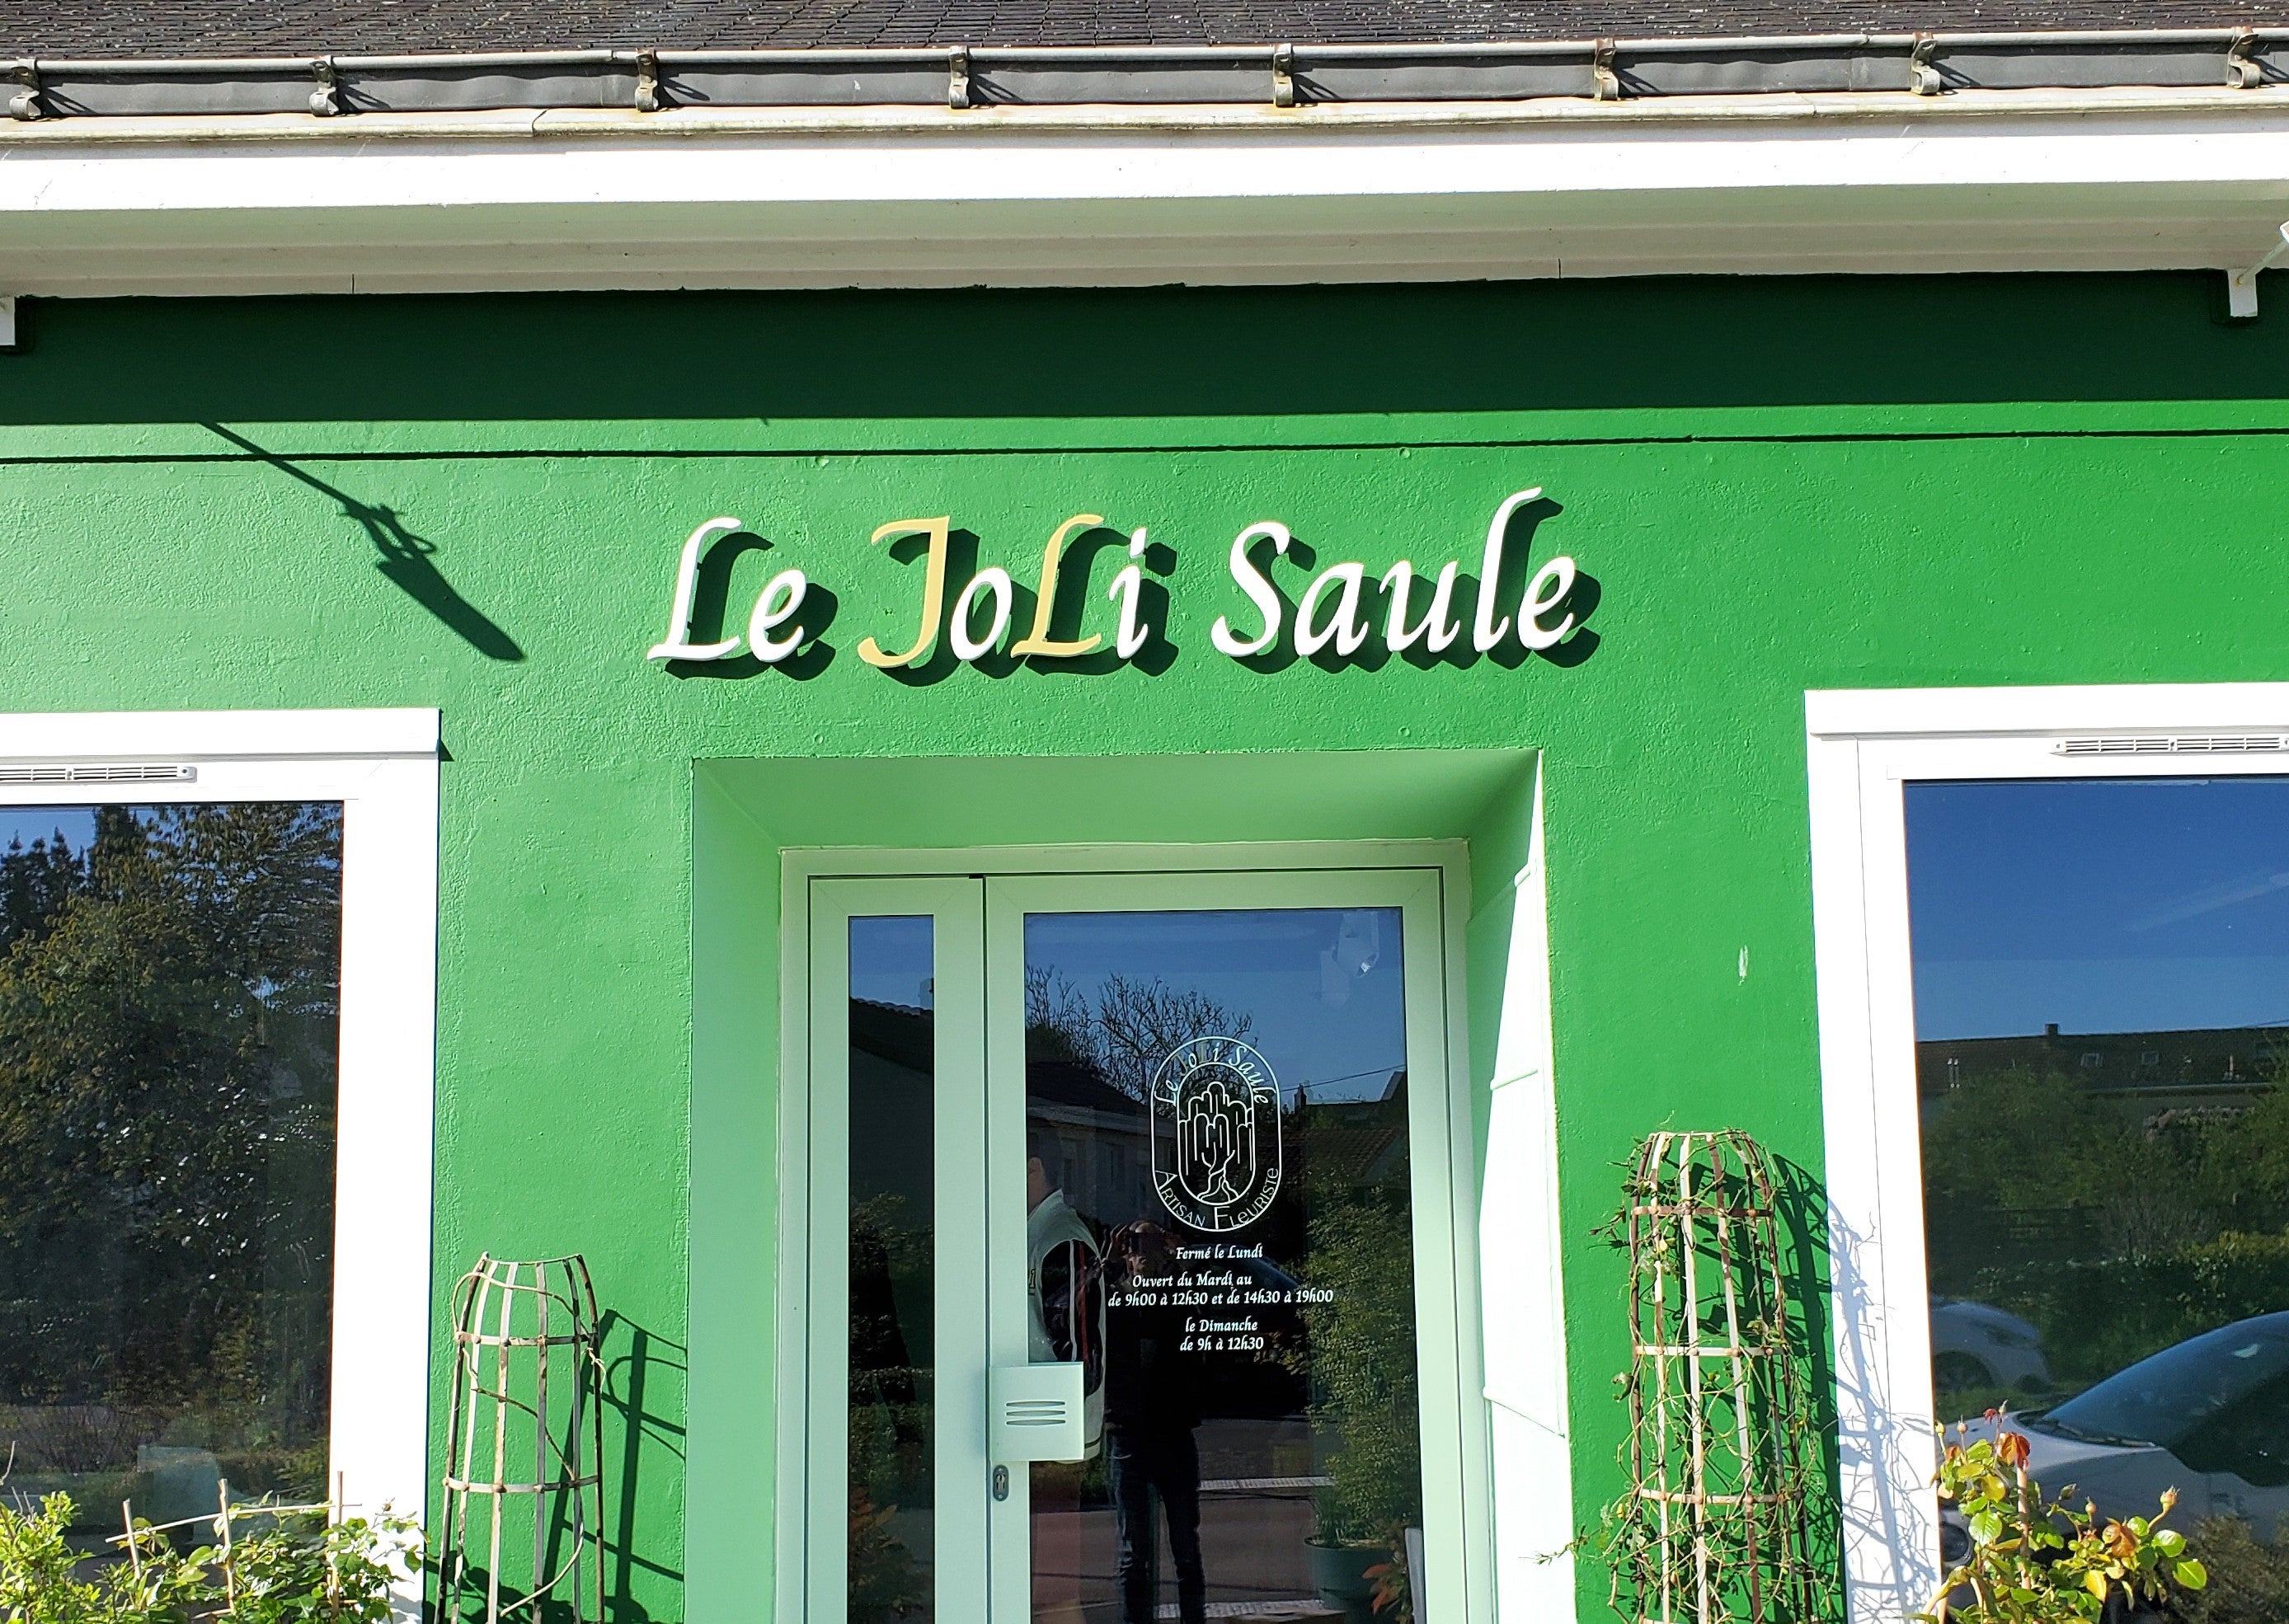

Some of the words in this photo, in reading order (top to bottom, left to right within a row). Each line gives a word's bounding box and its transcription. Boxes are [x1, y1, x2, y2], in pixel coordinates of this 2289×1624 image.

[646, 517, 808, 662] Le
[858, 514, 1150, 669] JoLi
[1210, 487, 1577, 658] Saule
[1154, 1078, 1179, 1108] Le
[1228, 1045, 1277, 1105] Saule
[1154, 1171, 1206, 1227] ARTISAN
[1175, 1246, 1210, 1260] Fermé
[1214, 1244, 1224, 1259] le
[1227, 1243, 1263, 1259] Lundi
[1132, 1274, 1173, 1288] Ouvert
[1177, 1272, 1192, 1286] du
[1196, 1270, 1233, 1286] Mardi
[1236, 1275, 1252, 1286] au
[1108, 1292, 1121, 1307] de
[1125, 1293, 1157, 1307] 9h00
[1159, 1292, 1168, 1306] à
[1172, 1292, 1208, 1305] 12h30
[1211, 1295, 1223, 1304] et
[1226, 1289, 1240, 1304] de
[1243, 1289, 1281, 1304] 14h30
[1283, 1289, 1292, 1303] à
[1295, 1288, 1333, 1303] 19h00
[1185, 1317, 1196, 1332] le
[1199, 1316, 1258, 1332] Dimanche
[1179, 1335, 1194, 1351] de
[1196, 1336, 1212, 1351] 9h
[1215, 1335, 1224, 1349] à
[1227, 1336, 1264, 1350] 12h30
